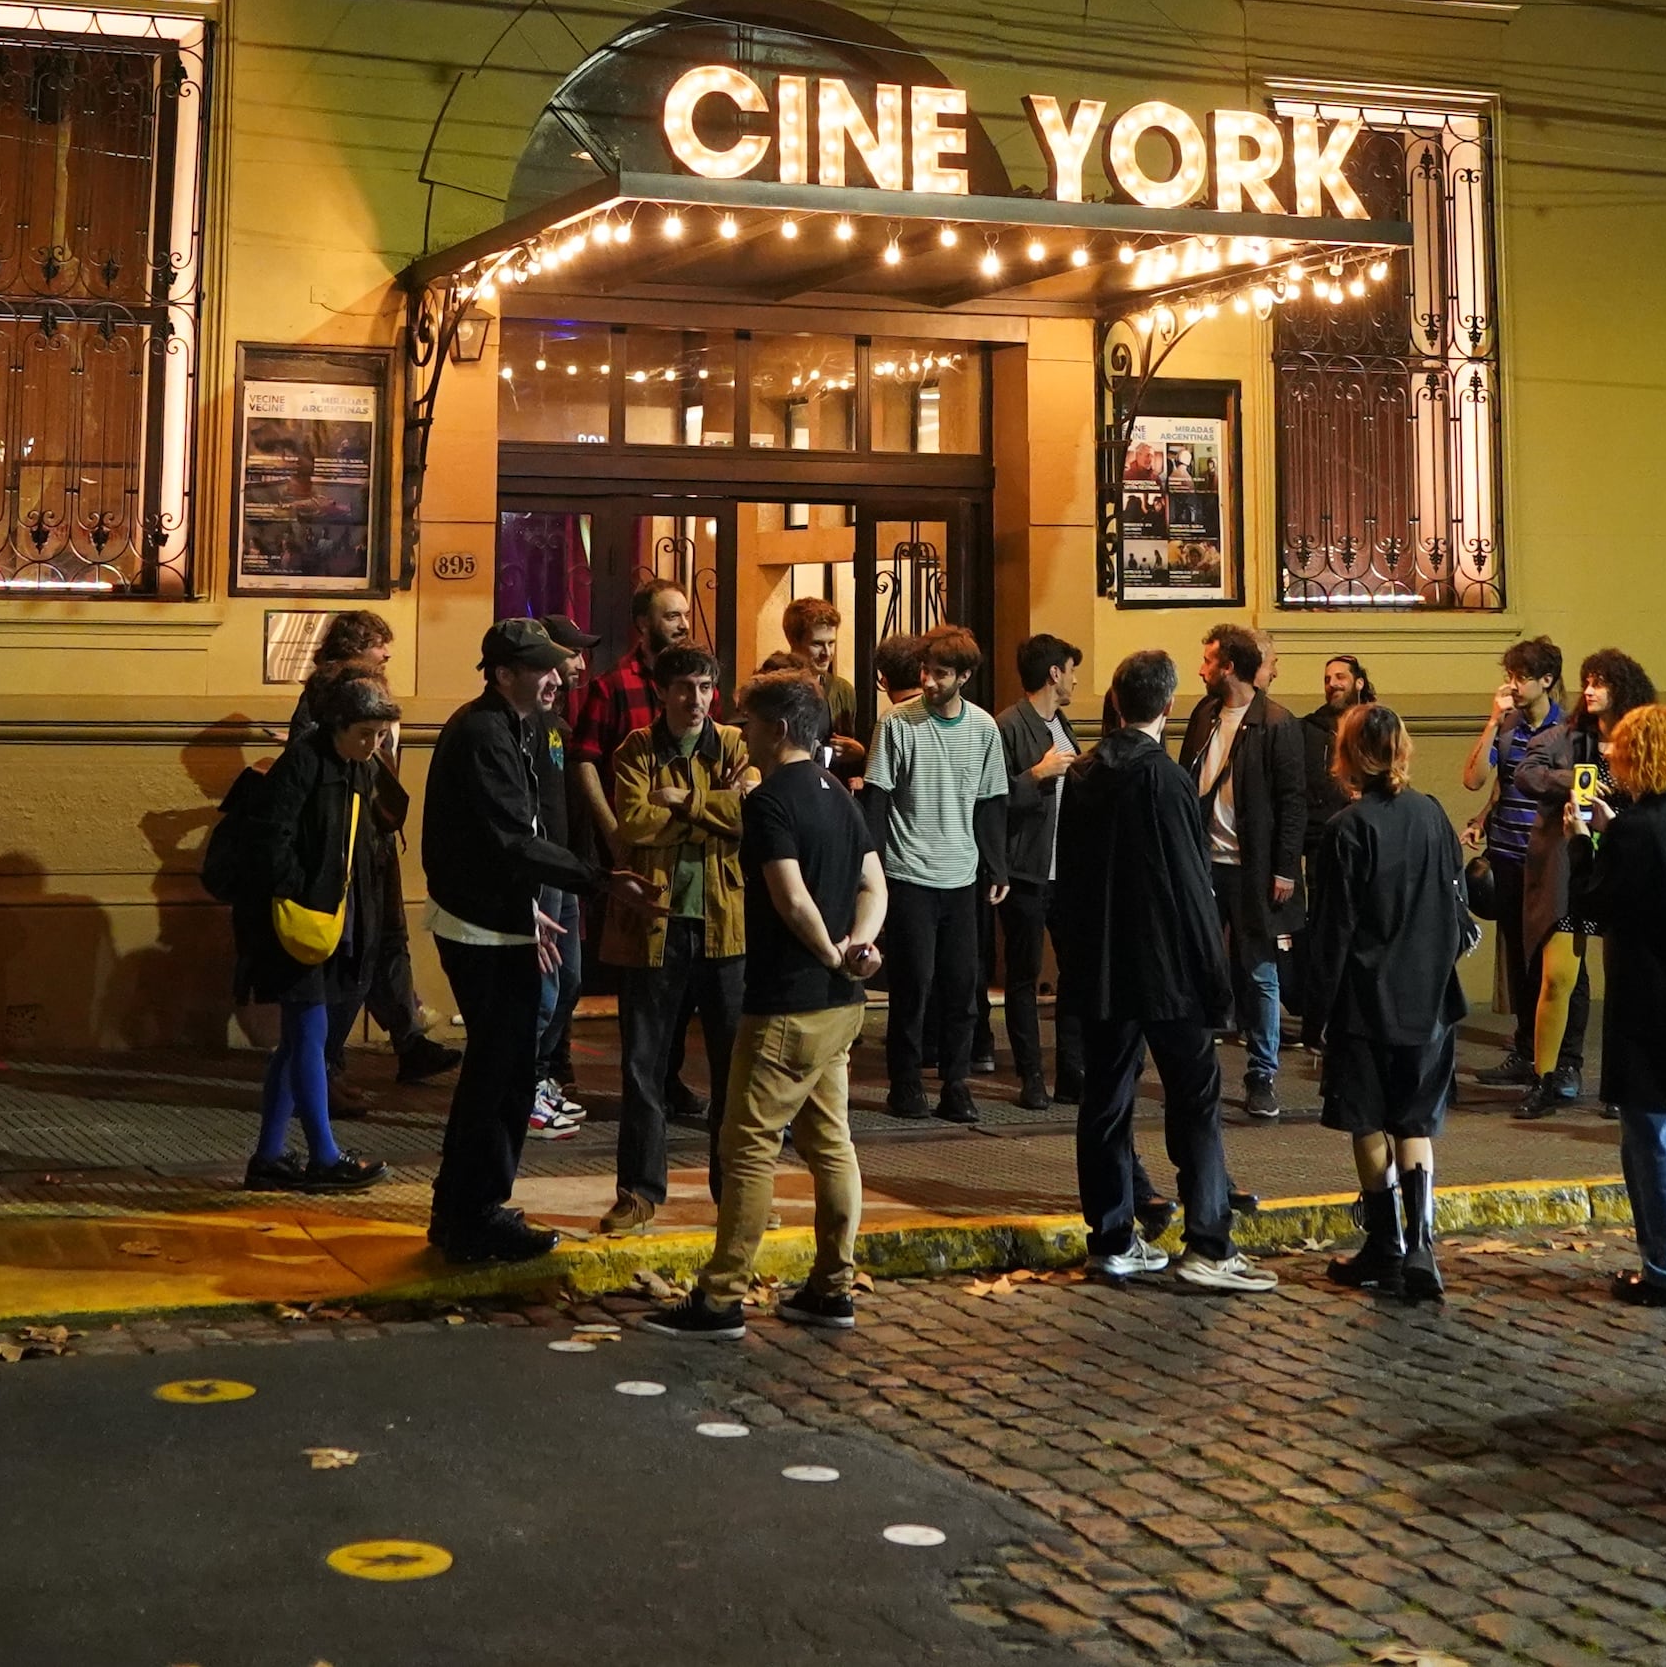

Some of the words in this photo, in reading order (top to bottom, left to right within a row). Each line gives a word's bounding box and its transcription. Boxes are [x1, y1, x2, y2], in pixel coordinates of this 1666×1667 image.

[663, 65, 970, 196] CINE
[1020, 93, 1373, 222] YORK
[249, 394, 286, 404] VECINE
[249, 404, 286, 413] VECINE
[301, 405, 370, 415] ARGENTINAS
[1174, 425, 1215, 434] MIRADAS
[1160, 433, 1215, 441] ARGENTINAS
[438, 555, 475, 575] 895
